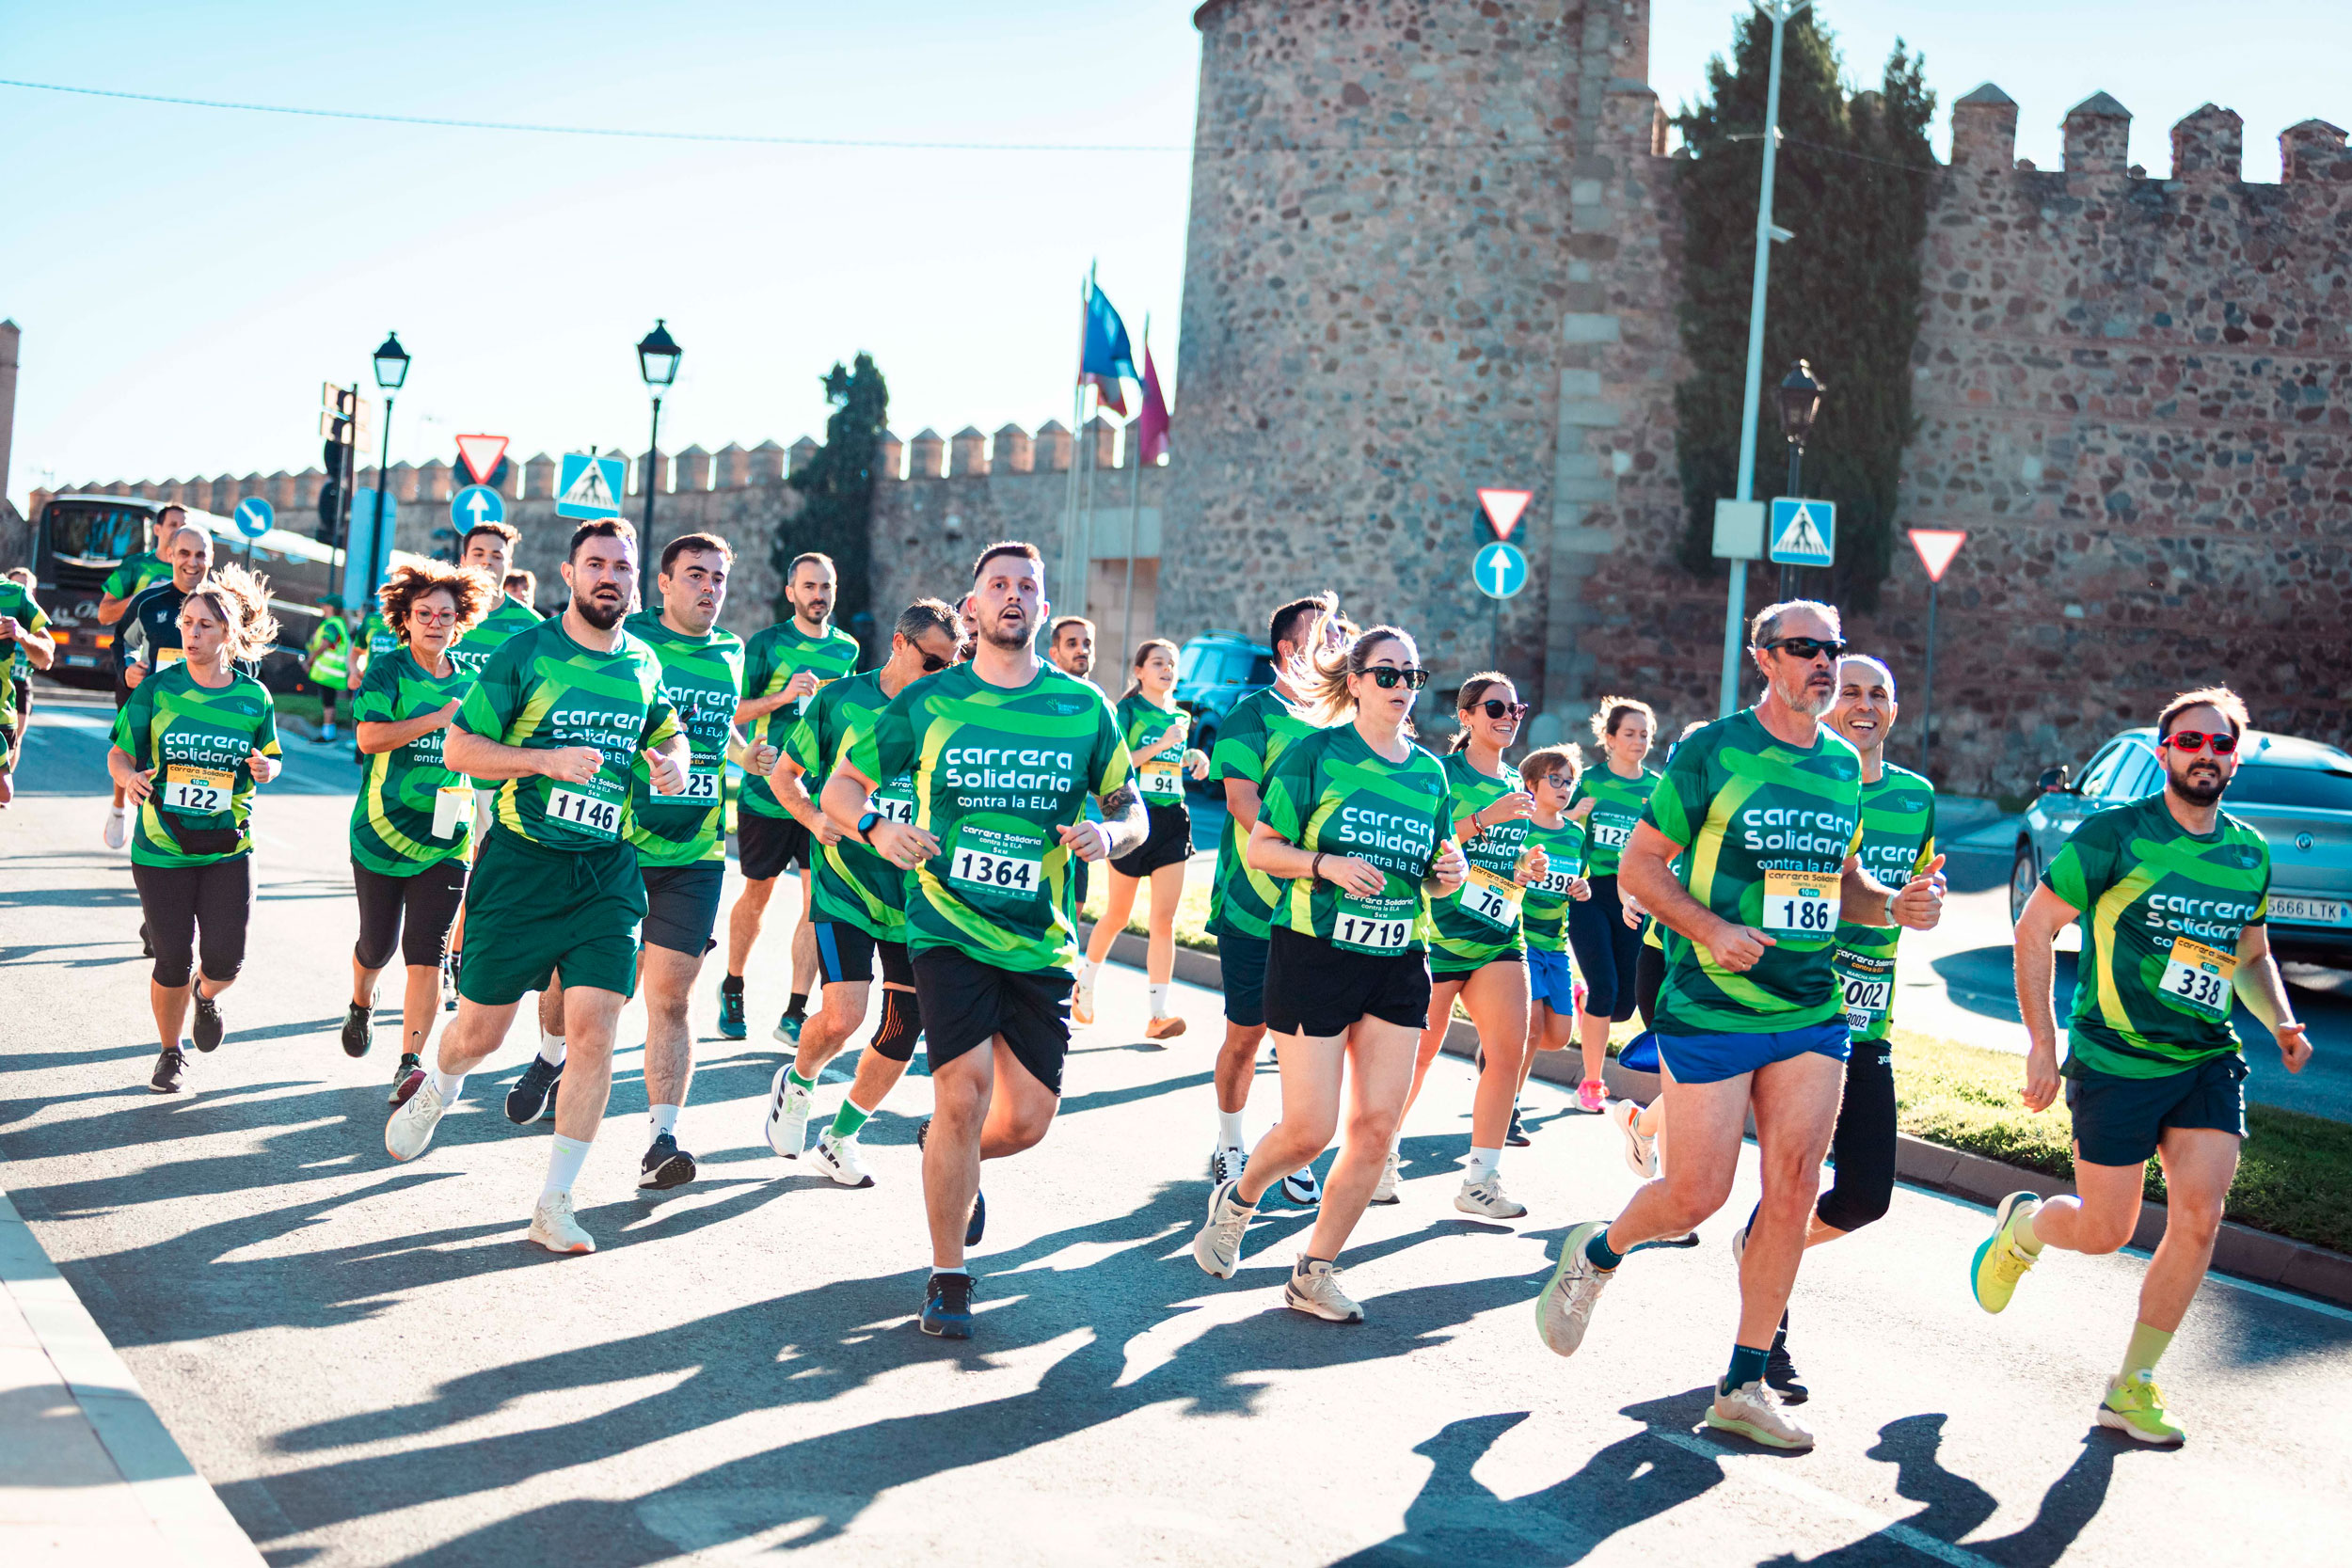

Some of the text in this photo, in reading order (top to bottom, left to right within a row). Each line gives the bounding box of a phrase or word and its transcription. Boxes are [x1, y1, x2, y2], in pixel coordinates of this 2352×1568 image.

[667, 687, 739, 708] arrera
[165, 733, 249, 752] carrera
[707, 727, 723, 739] ELA
[166, 747, 245, 767] Solidaria
[946, 748, 1073, 770] carrera
[170, 766, 200, 774] carrera
[202, 768, 233, 779] Solidaria
[946, 768, 1072, 792] Solidaria
[598, 778, 625, 792] Solidaria
[1155, 777, 1172, 792] 94
[179, 786, 218, 810] 122
[957, 795, 1057, 811] contra la ELA
[558, 794, 614, 830] 1146
[885, 801, 912, 824] 14
[1743, 808, 1852, 838] carrera
[962, 825, 1042, 846] carrera Solidaria
[979, 837, 1001, 847] contra
[1339, 824, 1431, 863] Solidari
[1744, 830, 1848, 858] Solidari
[1396, 857, 1406, 871] la
[1863, 846, 1917, 863] rera
[962, 853, 1030, 889] 1364
[1472, 865, 1500, 881] carrera
[1756, 858, 1804, 871] contra
[1807, 859, 1820, 873] la
[1769, 872, 1809, 881] carrera
[1344, 892, 1382, 906] carrera
[1479, 892, 1503, 918] 76
[2148, 894, 2255, 921] carrera
[2267, 899, 2336, 919] 5666 LTK
[1784, 900, 1828, 930] 186
[1344, 918, 1406, 946] 1719
[2145, 911, 2243, 940] Solidari
[1836, 949, 1874, 966] carrera
[2177, 940, 2216, 958] carrera
[1846, 970, 1868, 980] MARCHA
[1851, 962, 1872, 973] contra
[2177, 969, 2221, 1006] 338
[1847, 1012, 1867, 1028] 3002
